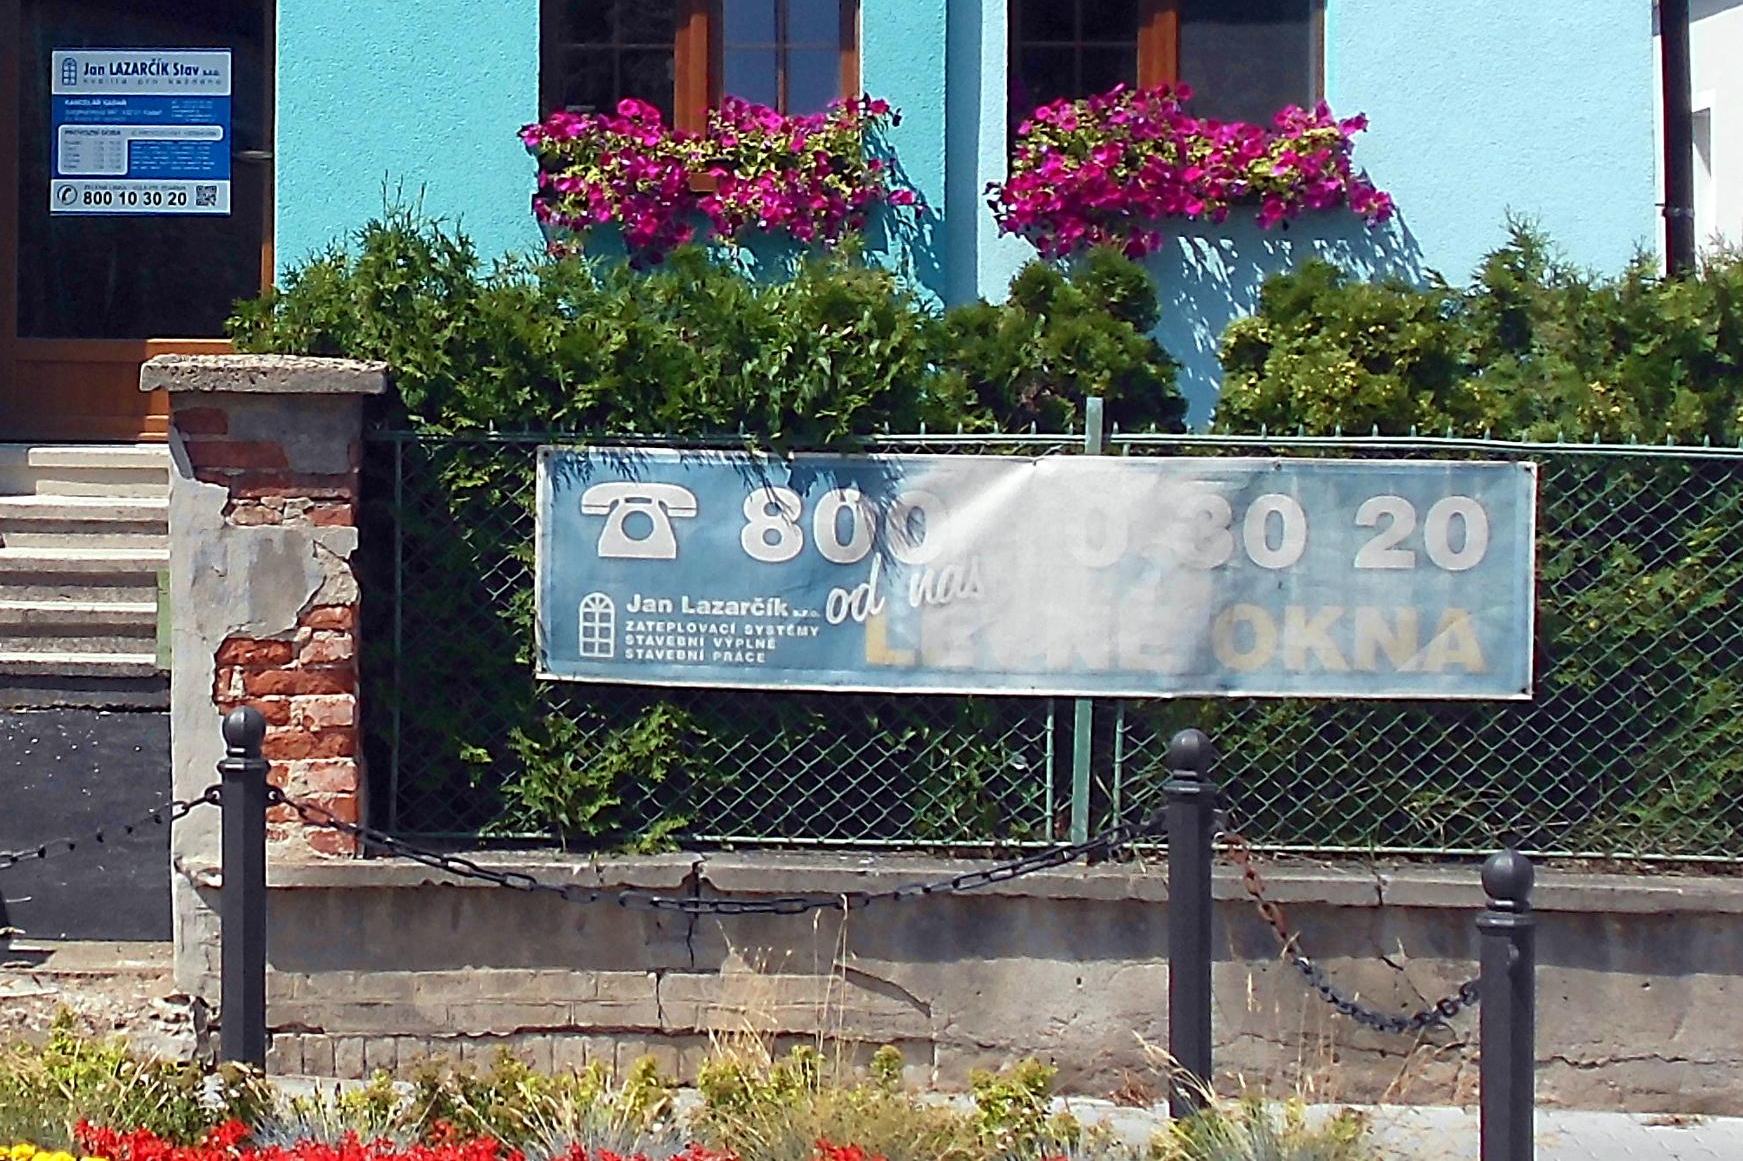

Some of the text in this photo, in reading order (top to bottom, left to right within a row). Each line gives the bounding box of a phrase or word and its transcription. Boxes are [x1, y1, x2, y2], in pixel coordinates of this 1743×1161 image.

[84, 62, 104, 76] Jan
[109, 57, 169, 76] LAZARČÍK
[173, 62, 199, 76] Stav
[83, 191, 187, 206] 800 10 30 20
[741, 486, 946, 565] 800
[1174, 492, 1307, 570] 30
[1353, 495, 1489, 571] 20
[825, 552, 886, 625] od
[626, 594, 672, 614] Jan
[681, 596, 789, 618] Lazarčík
[625, 619, 820, 637] ZATEPLOVACÍ SYSTÉMY
[1212, 602, 1488, 673] OKNA
[625, 633, 705, 647] STAVEBNÍ
[625, 648, 766, 664] STAVEBNÍ PRÁCE
